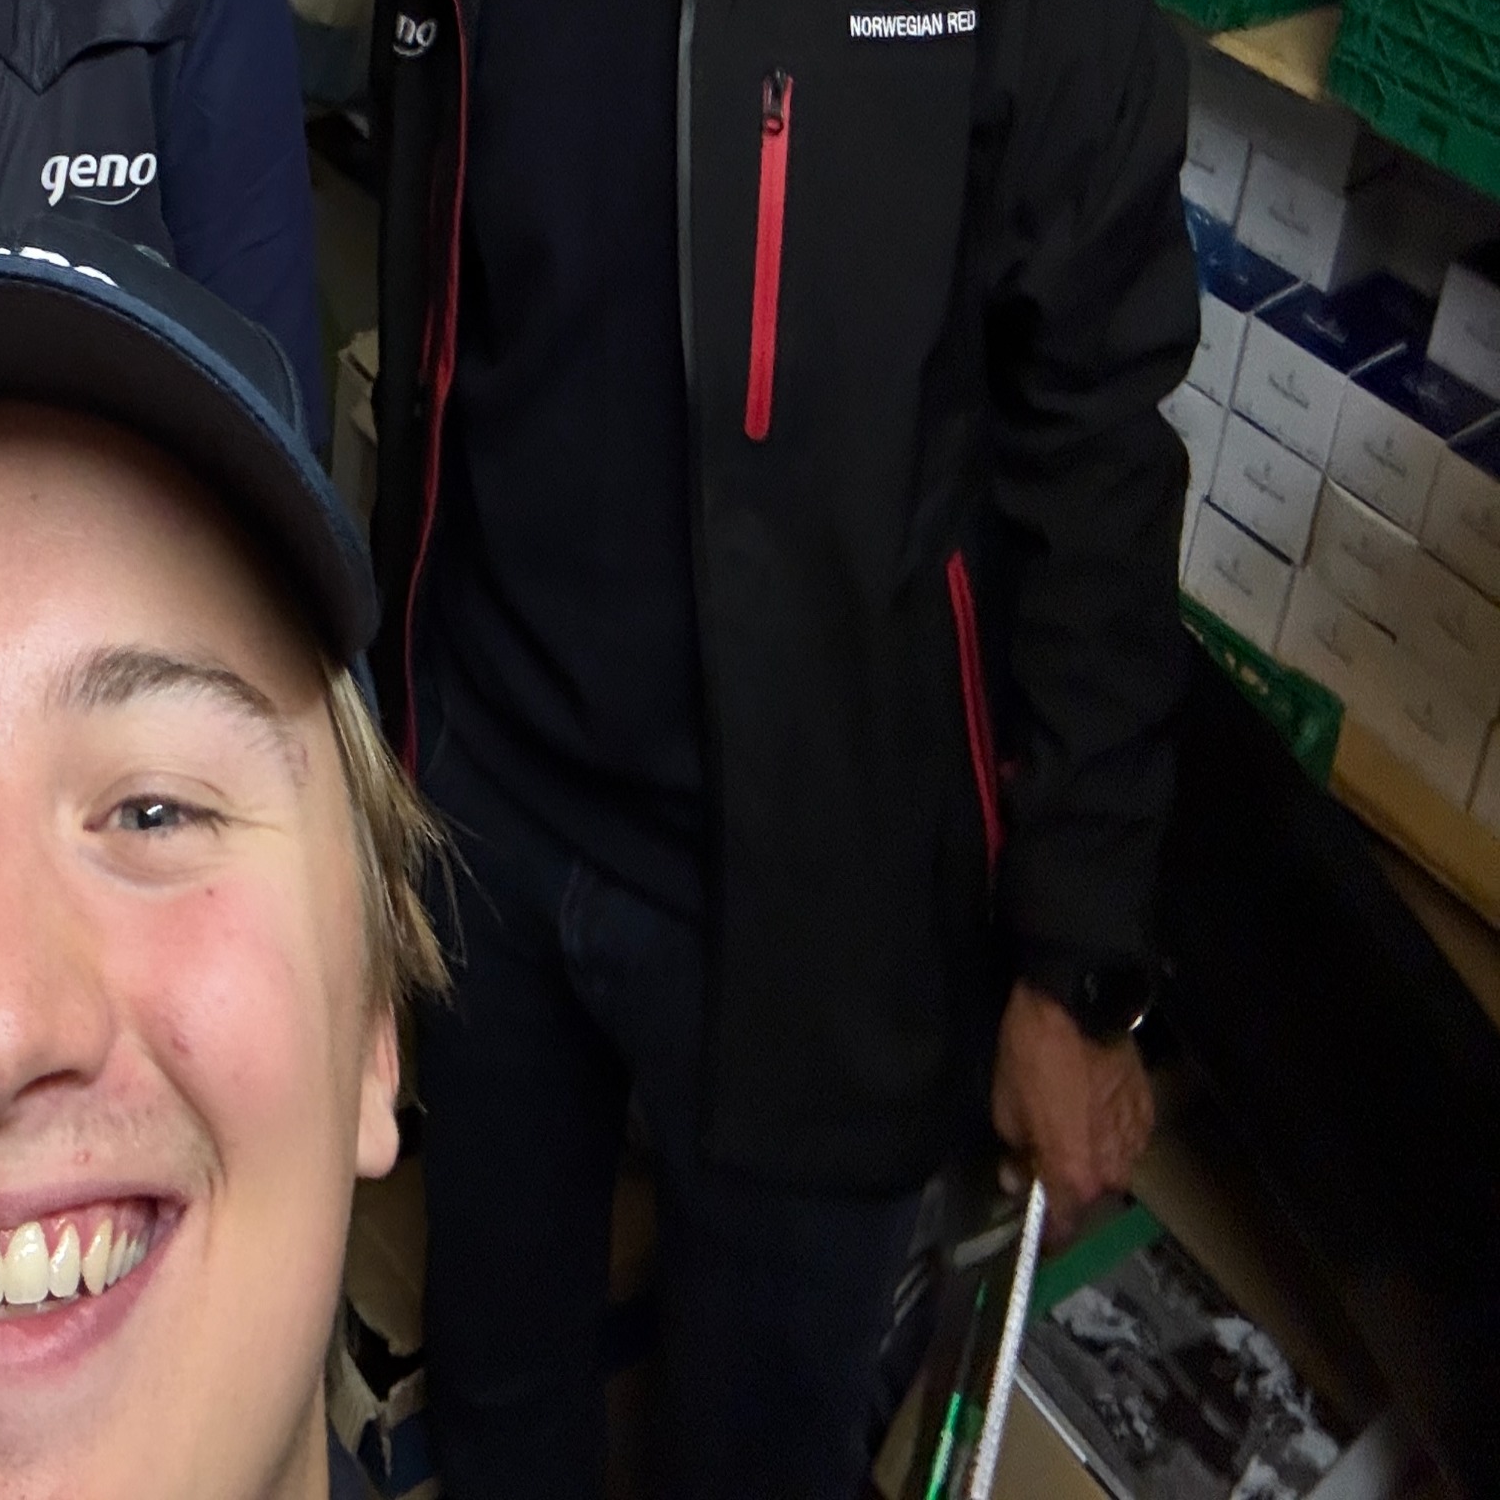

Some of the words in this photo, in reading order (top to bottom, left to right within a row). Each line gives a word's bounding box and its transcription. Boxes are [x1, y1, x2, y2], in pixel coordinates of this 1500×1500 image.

[850, 12, 944, 38] NORWEGIAN
[947, 10, 977, 33] RED
[40, 152, 157, 207] geno
